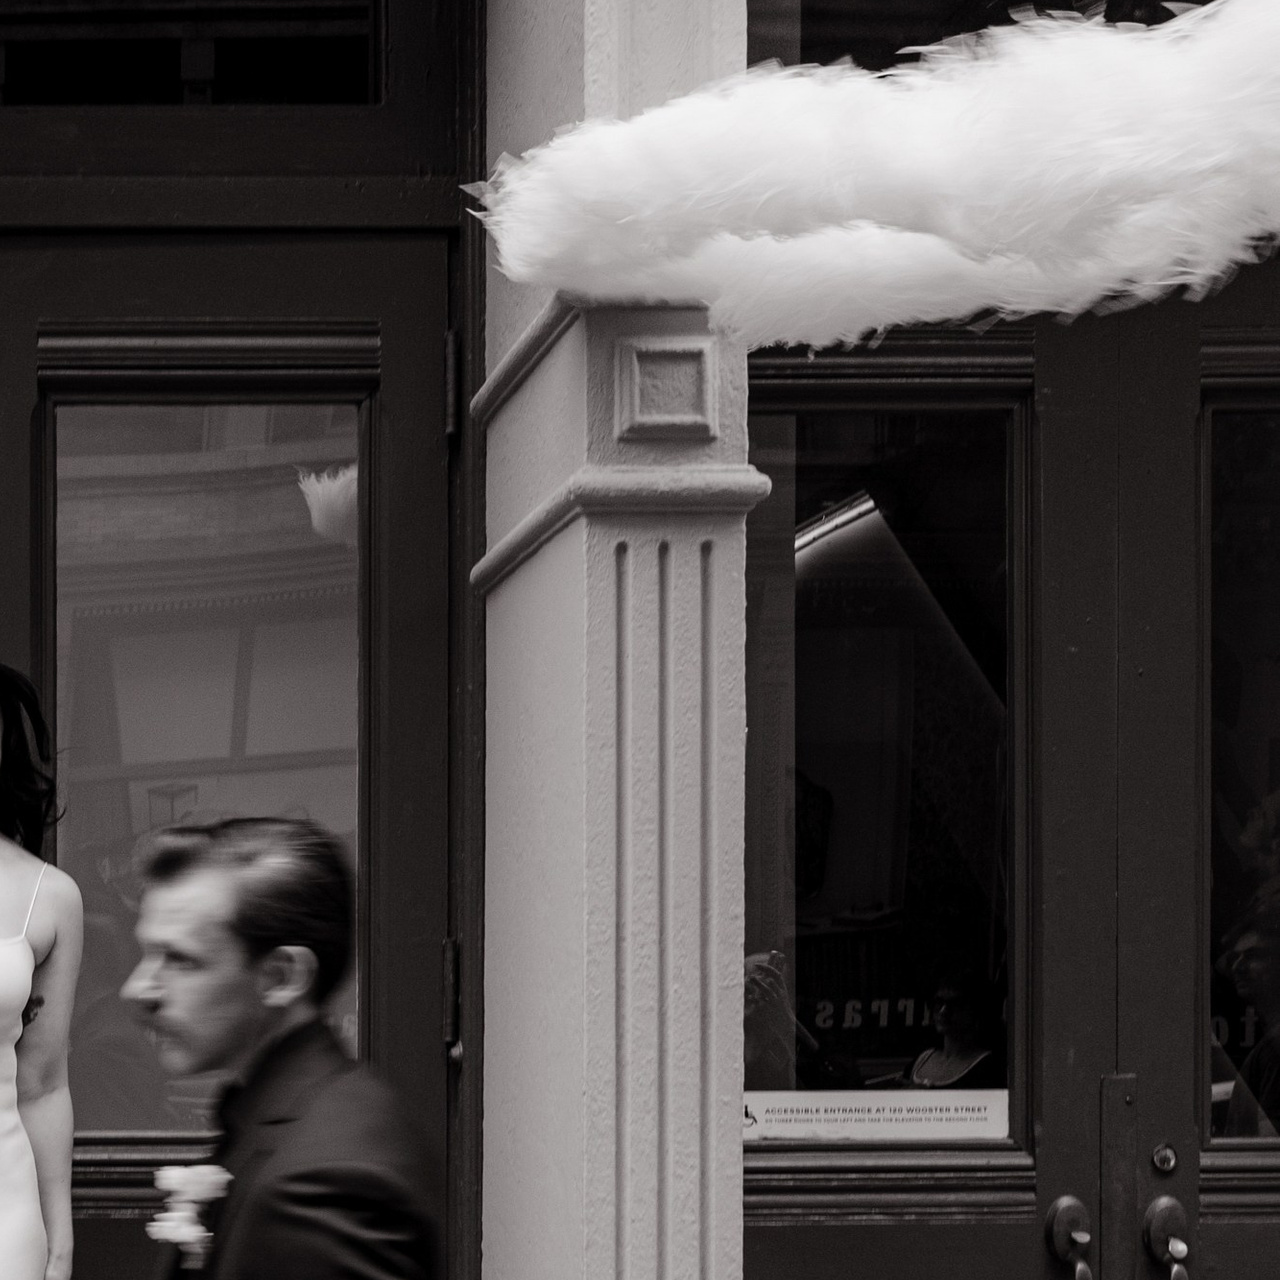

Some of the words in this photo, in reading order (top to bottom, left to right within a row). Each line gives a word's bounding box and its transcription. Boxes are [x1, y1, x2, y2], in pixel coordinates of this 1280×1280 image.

[765, 1106, 821, 1115] ACCESSIBLE
[823, 1106, 873, 1115] ENTRANCE
[875, 1105, 887, 1115] AT
[888, 1105, 904, 1115] 120
[906, 1105, 952, 1115] WOOSTER
[954, 1105, 988, 1115] STREET
